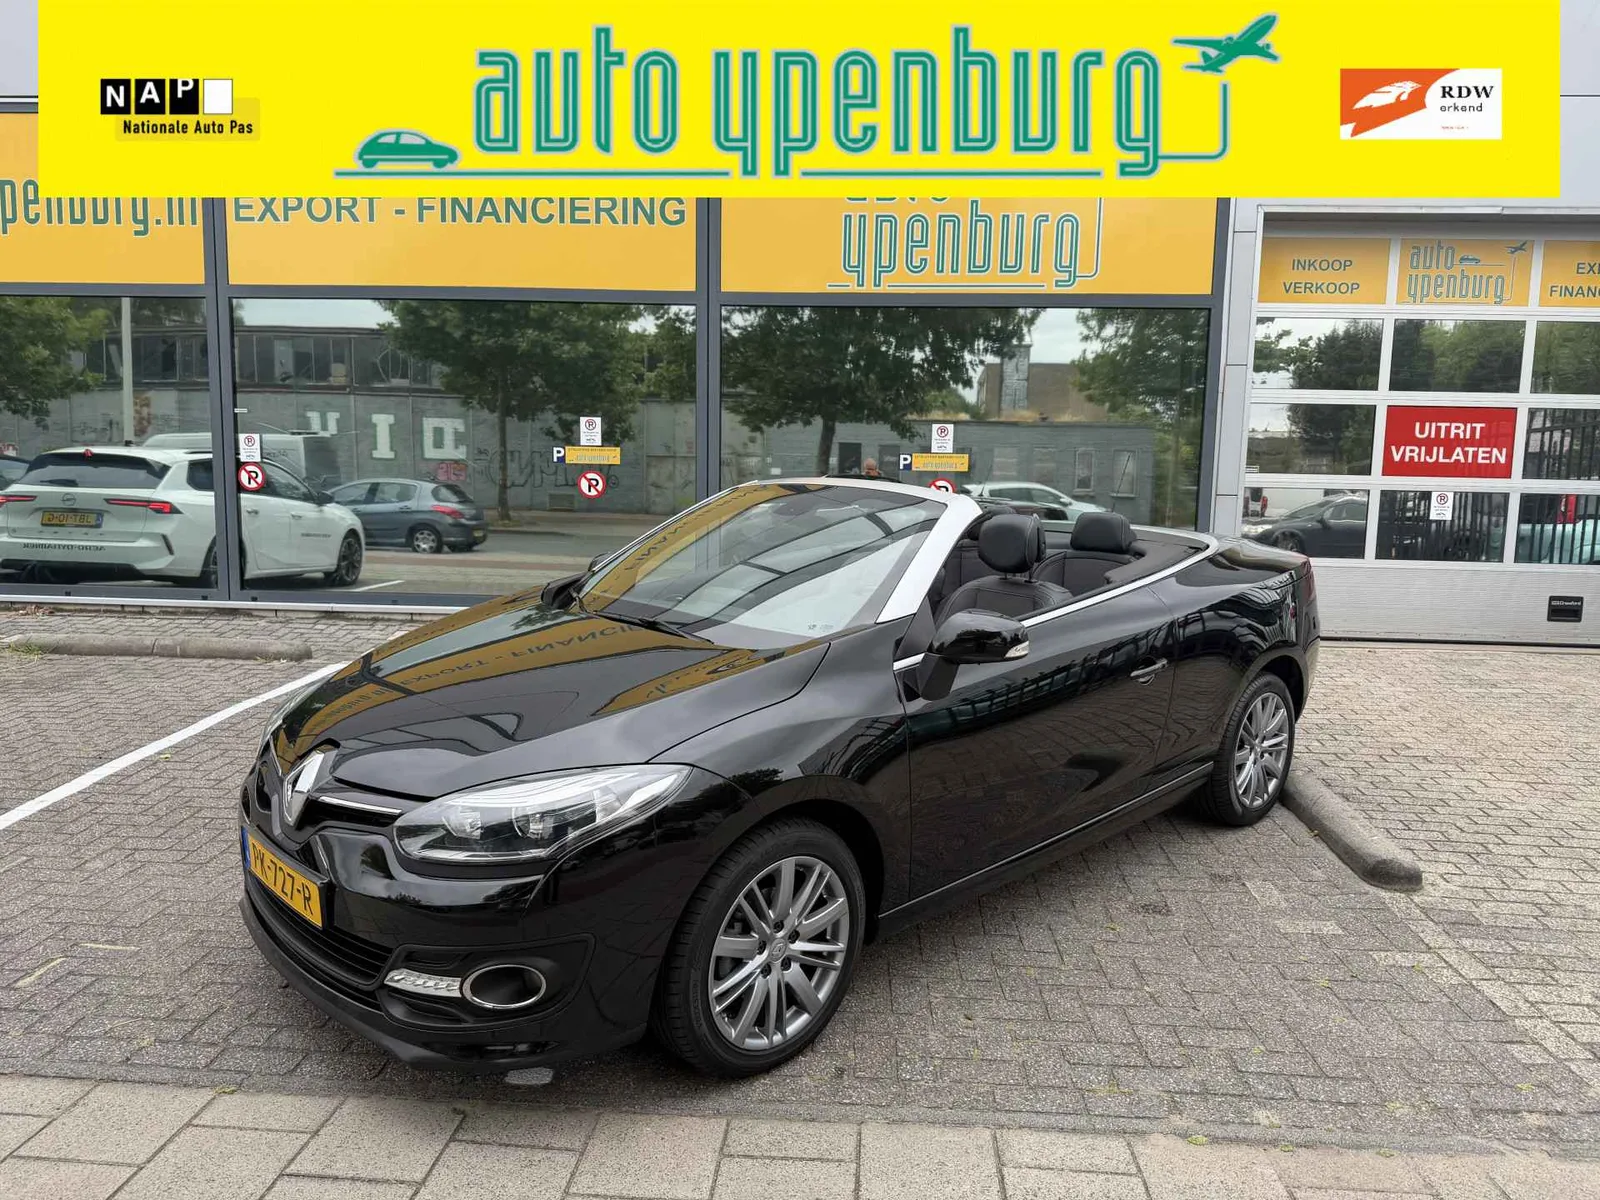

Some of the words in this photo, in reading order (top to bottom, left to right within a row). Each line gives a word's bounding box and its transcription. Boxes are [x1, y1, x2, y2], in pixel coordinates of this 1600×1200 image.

[234, 197, 382, 222] EXPORT
[417, 197, 686, 226] FINANCIERING
[842, 199, 1080, 288] ypenburg
[1409, 239, 1456, 270] auto
[1292, 258, 1353, 271] INKOOP
[1283, 281, 1360, 294] VERKOOP
[1407, 269, 1505, 305] ypenburg
[1550, 285, 1600, 298] FINAN
[1415, 422, 1486, 439] UITRIT
[1391, 445, 1507, 464] VRIJLATEN
